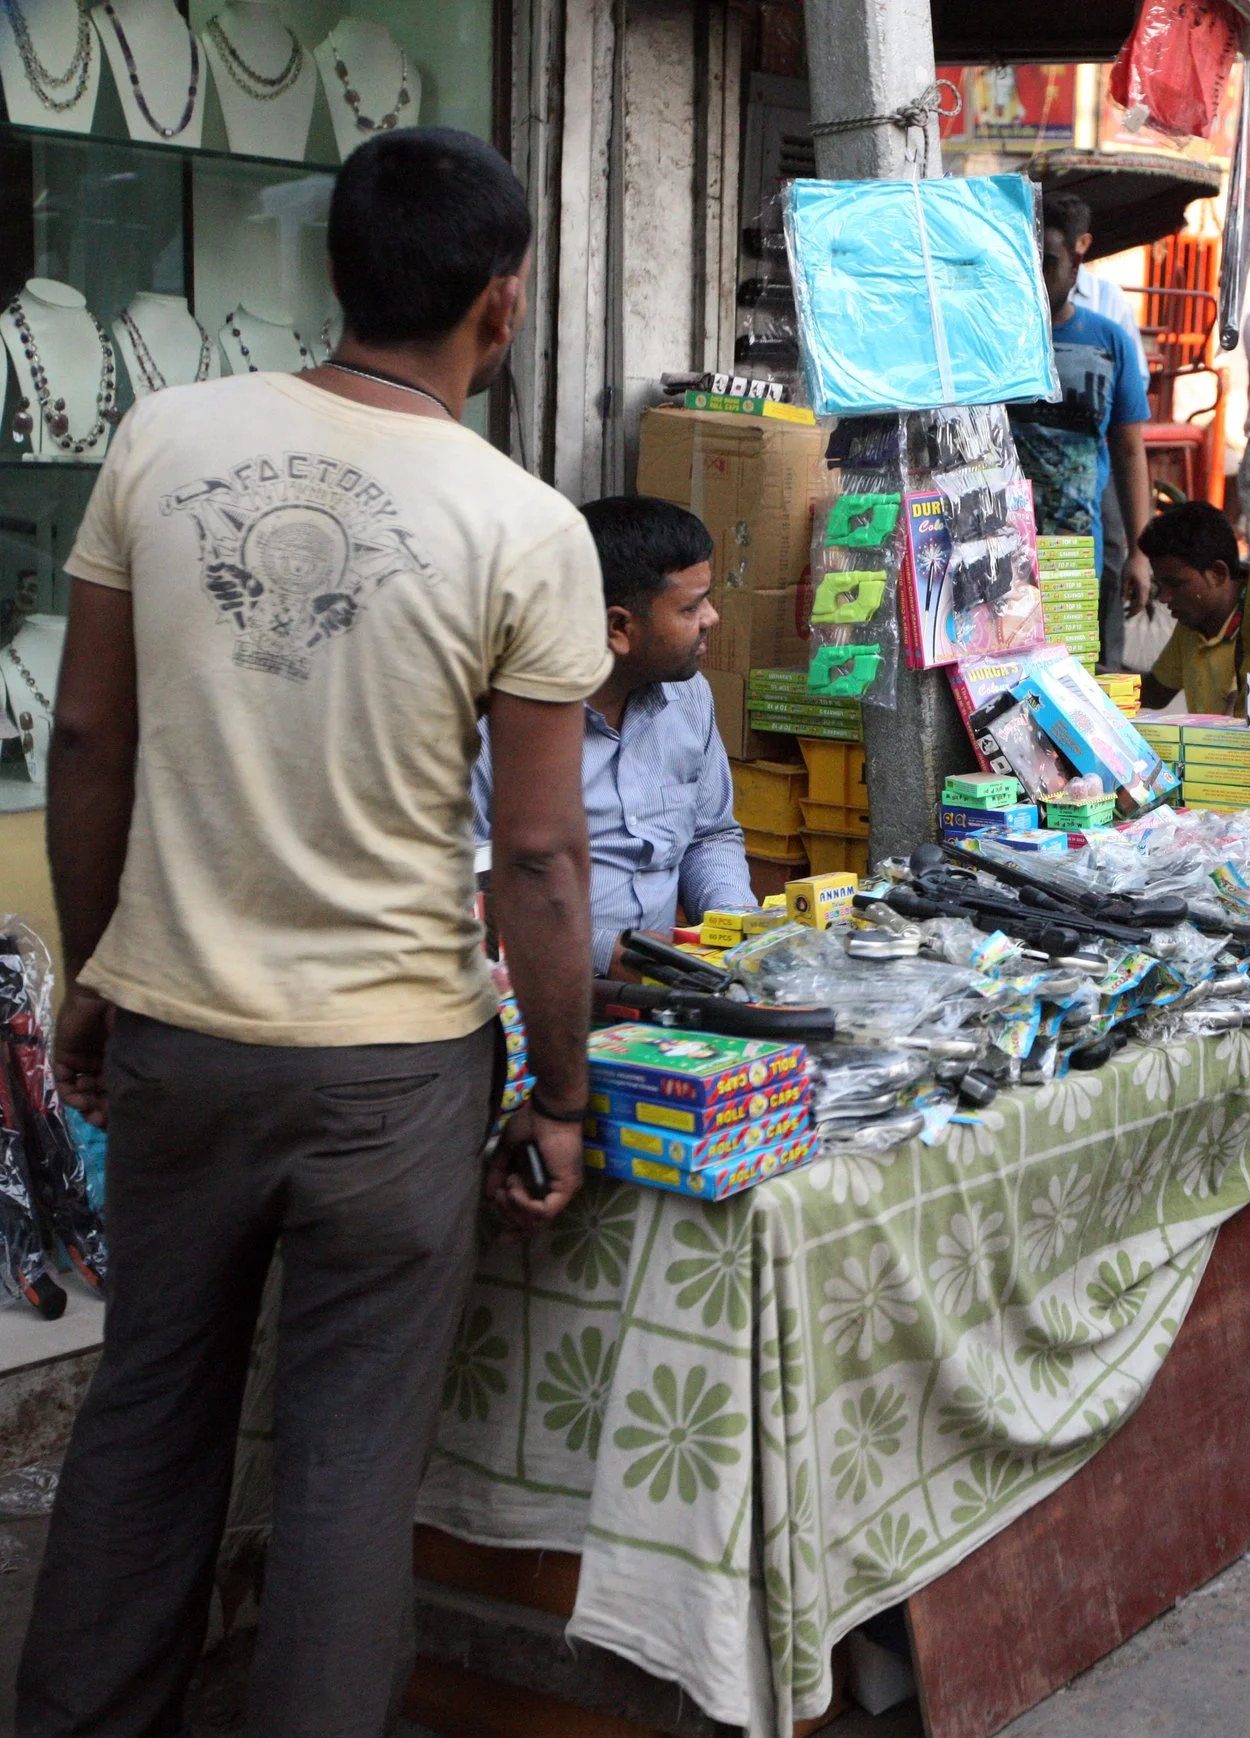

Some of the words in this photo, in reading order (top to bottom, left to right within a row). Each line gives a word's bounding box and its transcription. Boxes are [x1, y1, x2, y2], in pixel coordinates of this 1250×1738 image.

[233, 453, 399, 517] FACTORY
[911, 500, 945, 518] DUR
[818, 884, 856, 903] ANNAM
[719, 916, 733, 926] PCS
[718, 933, 733, 943] PCS
[768, 1054, 798, 1076] ROLL
[715, 1072, 749, 1095] CAPS
[714, 1106, 747, 1127] ROLL
[769, 1085, 801, 1108] CAPS
[708, 1138, 740, 1158] ROLL
[766, 1116, 799, 1139] CAPS
[728, 1167, 758, 1187] ROLL
[780, 1144, 809, 1165] CAPS
